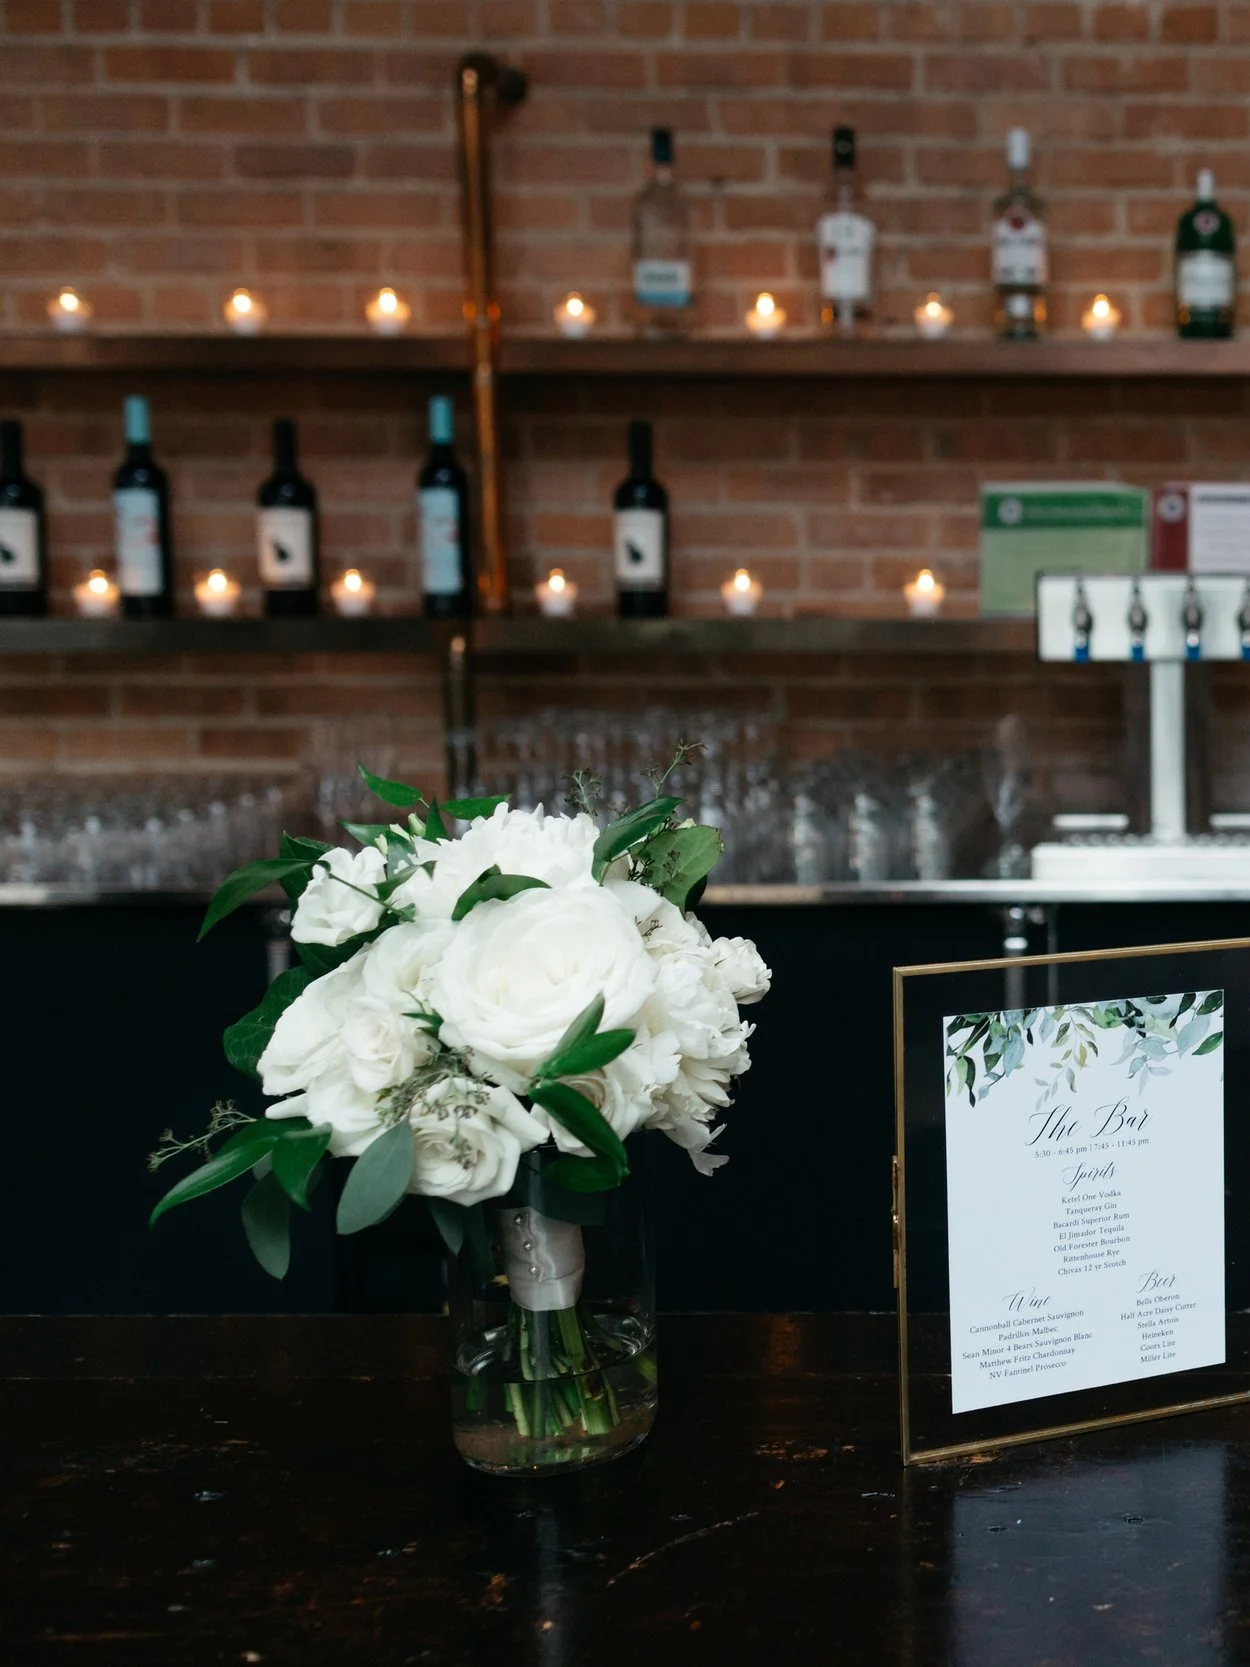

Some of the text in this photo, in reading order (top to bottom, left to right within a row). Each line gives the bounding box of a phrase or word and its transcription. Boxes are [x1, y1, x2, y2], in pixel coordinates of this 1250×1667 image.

[1024, 1096, 1154, 1146] The Bar
[1035, 1150, 1051, 1158] 5:30
[1058, 1146, 1074, 1155] 6:45
[1094, 1142, 1109, 1151] 7:45
[1117, 1139, 1136, 1148] 11:45
[1138, 1138, 1149, 1146] pm
[1062, 1161, 1117, 1192] Spirits
[1061, 1195, 1080, 1204] Ketel
[1099, 1190, 1121, 1198] Vodka
[1066, 1204, 1102, 1215] Tanqueray
[1053, 1220, 1080, 1229] Bacardi
[1081, 1215, 1111, 1226] Superior
[1068, 1229, 1096, 1240] Jimador
[1100, 1225, 1124, 1234] Tequila
[1069, 1241, 1098, 1250] Forester
[1101, 1236, 1130, 1245] Bourbon
[1063, 1251, 1104, 1263] Rittenhouse
[1058, 1267, 1081, 1275] Chivas
[1104, 1259, 1126, 1268] Scotch
[1136, 1268, 1178, 1294] Beer
[1002, 1287, 1053, 1312] Wine
[1154, 1294, 1179, 1303] Oberon
[1155, 1306, 1173, 1314] Daisy
[1175, 1302, 1197, 1311] Cutter
[970, 1310, 1084, 1333] Cannonball Cabernet Sauvignon
[1138, 1317, 1179, 1329] Stella Artois
[998, 1326, 1058, 1341] Padrillos Malbec
[1142, 1329, 1173, 1340] Heineken
[962, 1352, 980, 1360] Sean
[982, 1346, 1004, 1356] Minor
[1014, 1343, 1033, 1351] Bears
[1035, 1336, 1071, 1347] Sauvignon
[1074, 1332, 1092, 1340] Blanc
[980, 1348, 1076, 1369] Matthew Fritz Chardonnay
[1141, 1355, 1160, 1363] Miller
[1004, 1366, 1033, 1377] Fantinel
[1036, 1361, 1067, 1371] Prosecco
